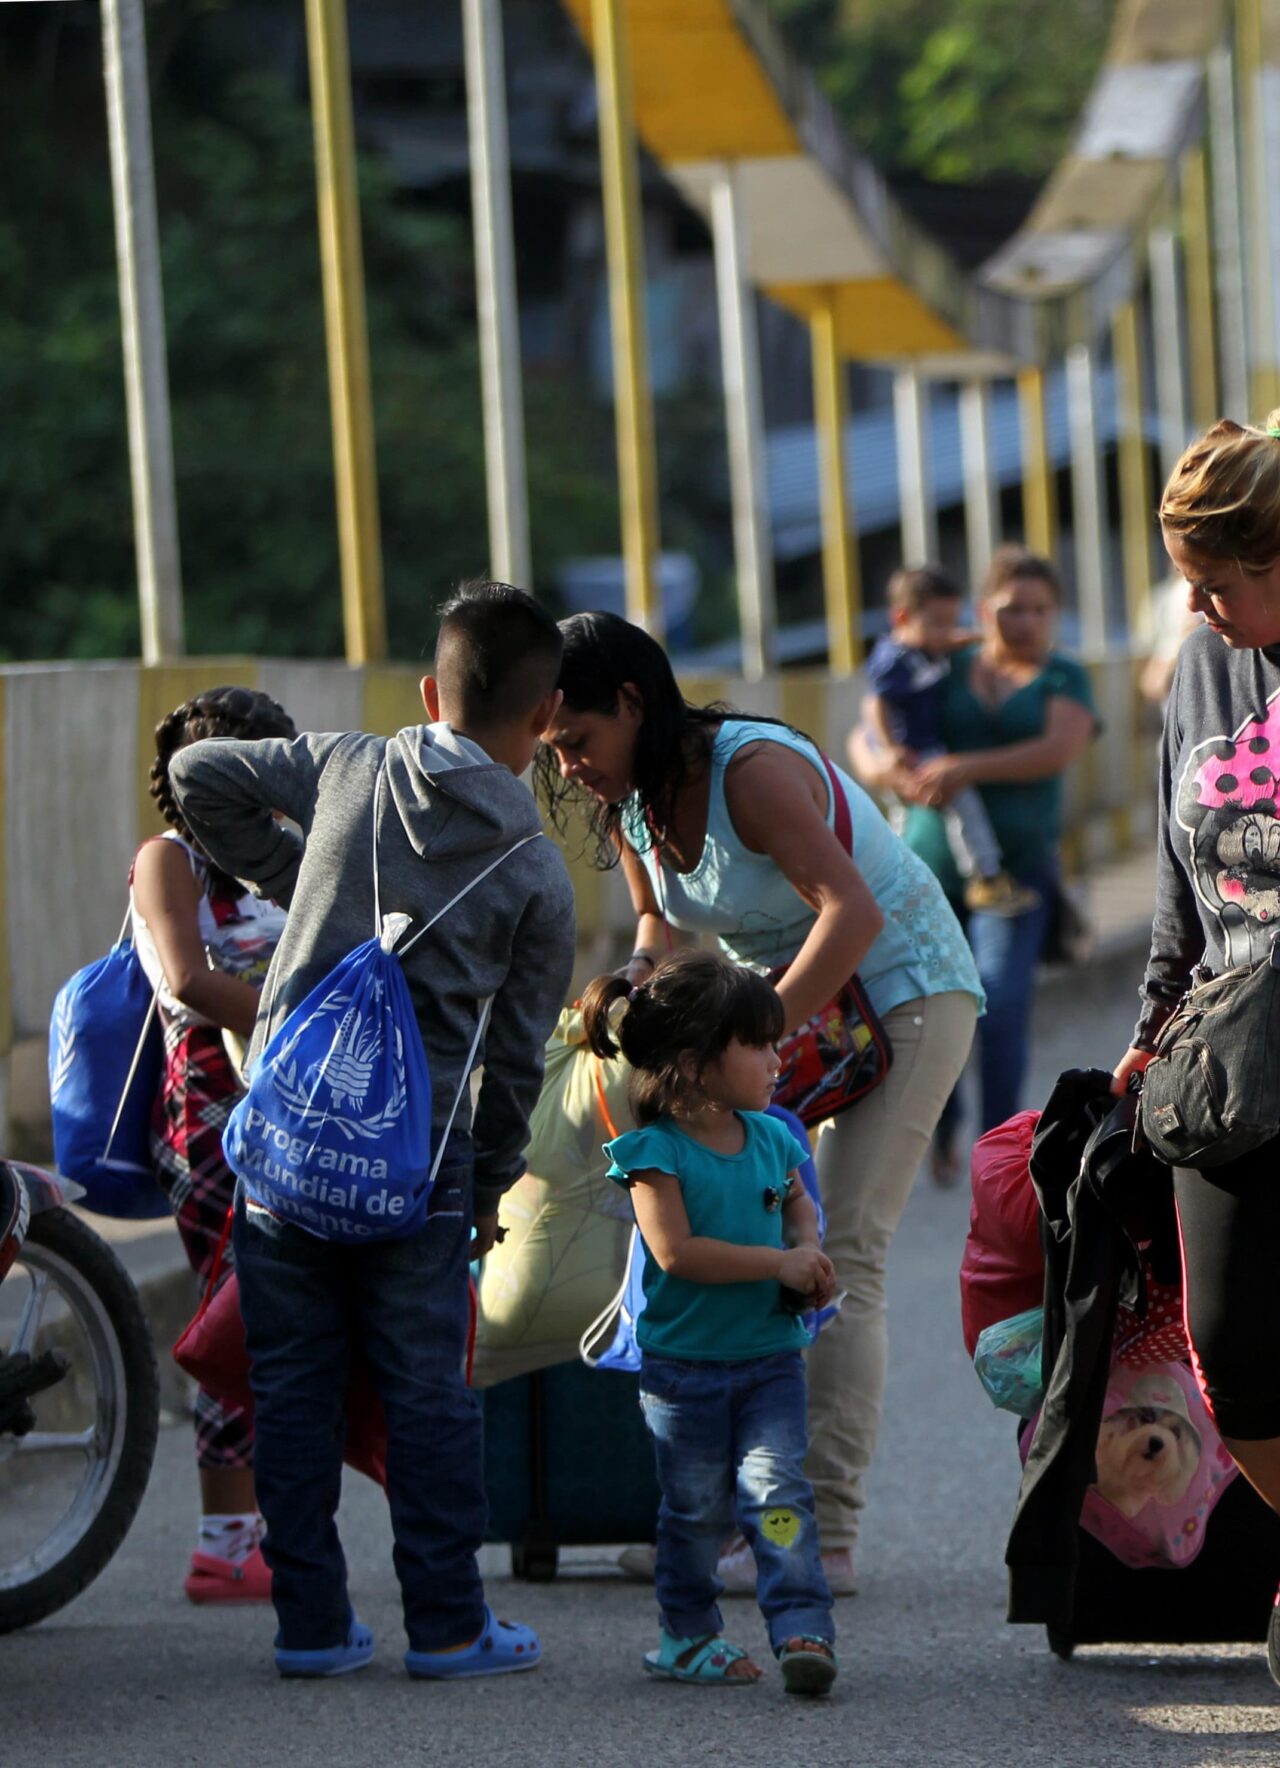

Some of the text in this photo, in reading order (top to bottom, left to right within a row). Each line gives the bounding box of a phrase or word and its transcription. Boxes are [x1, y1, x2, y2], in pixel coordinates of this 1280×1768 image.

[236, 1141, 406, 1216] Mundial de
[244, 1107, 388, 1180] Programa
